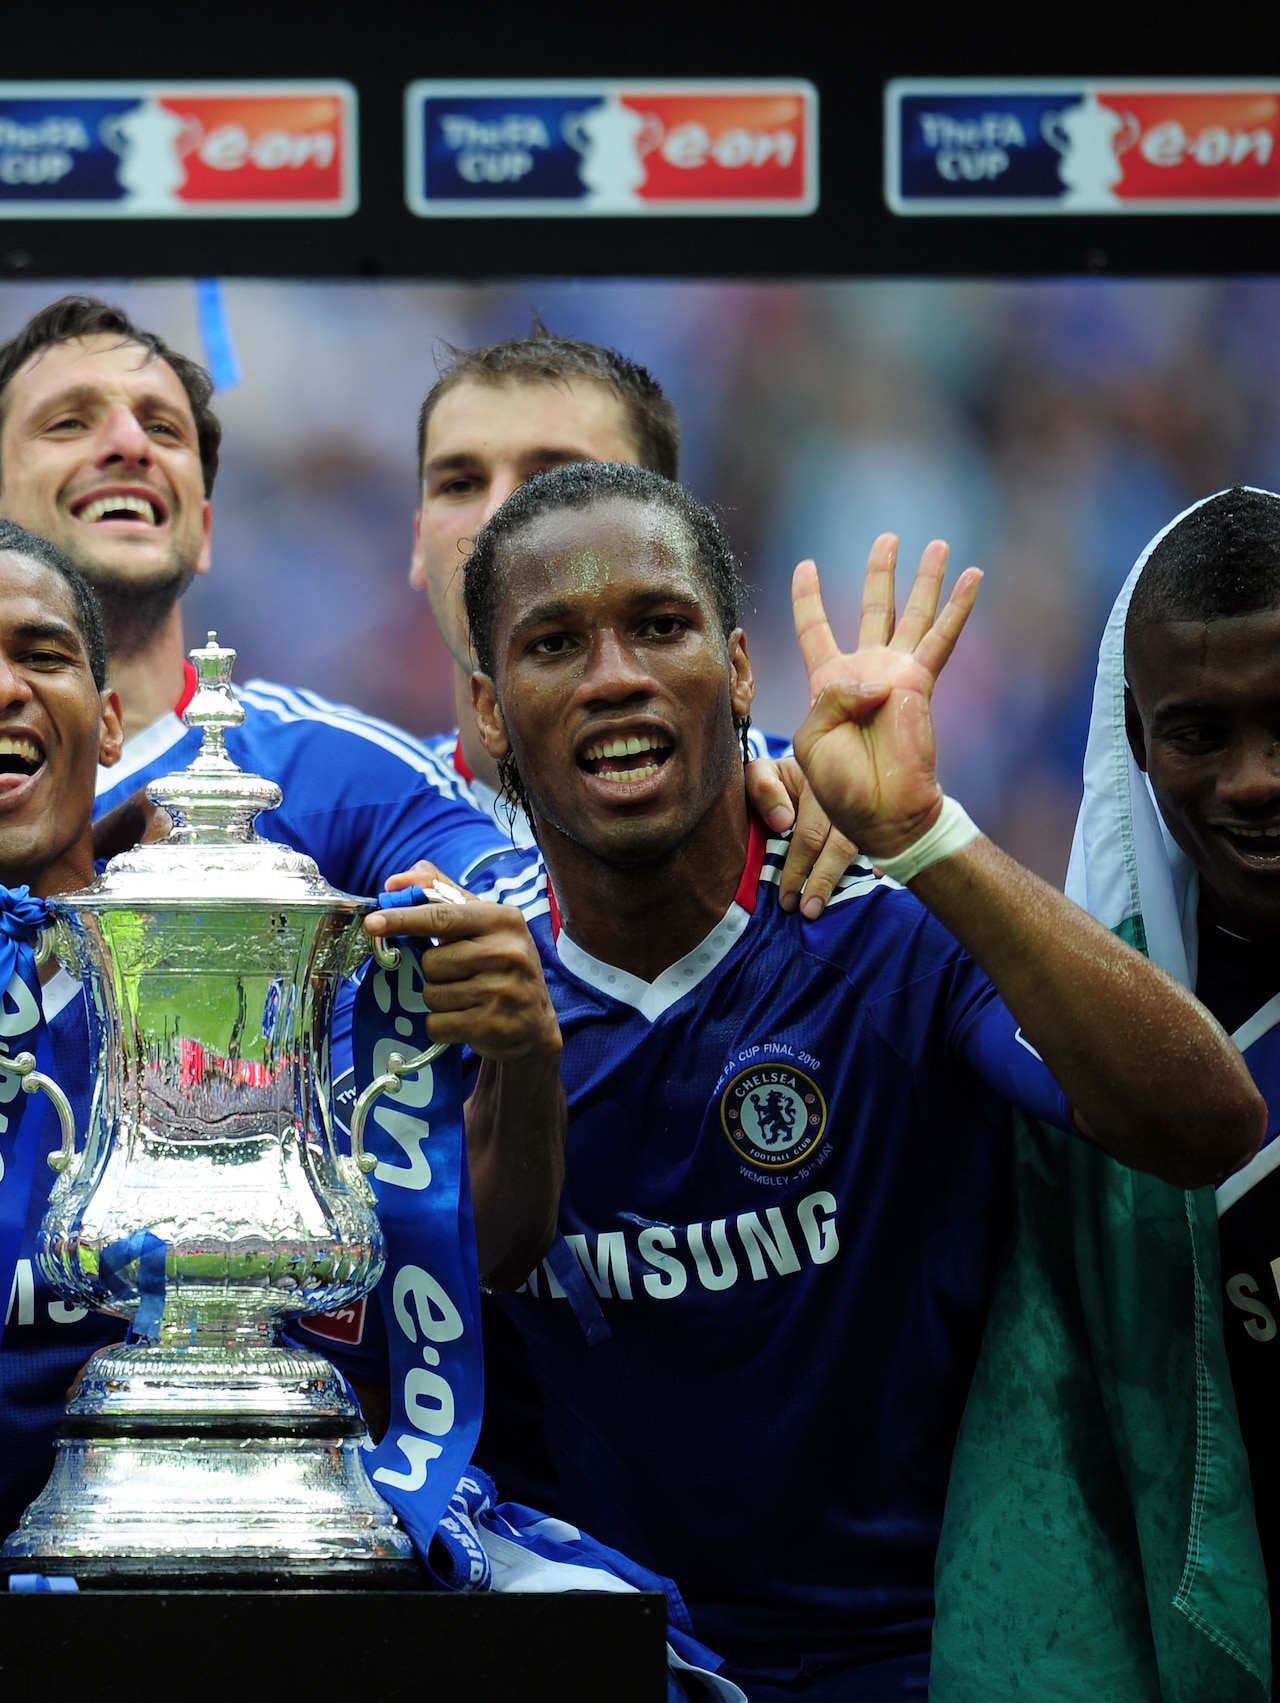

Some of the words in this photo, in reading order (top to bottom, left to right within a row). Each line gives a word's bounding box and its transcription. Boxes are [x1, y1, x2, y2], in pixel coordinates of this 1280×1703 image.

[456, 149, 533, 183] CUP
[936, 148, 1009, 181] CUP
[724, 1061, 736, 1075] FA
[738, 1045, 760, 1062] CUP
[763, 1042, 795, 1056] FINAL
[797, 1051, 821, 1070] 2010
[734, 1072, 796, 1097] CHELSEA
[739, 1165, 789, 1186] WEMBLEY
[815, 1142, 834, 1165] MAY
[749, 1148, 791, 1162] FOOTBALL
[793, 1137, 812, 1155] CLUB
